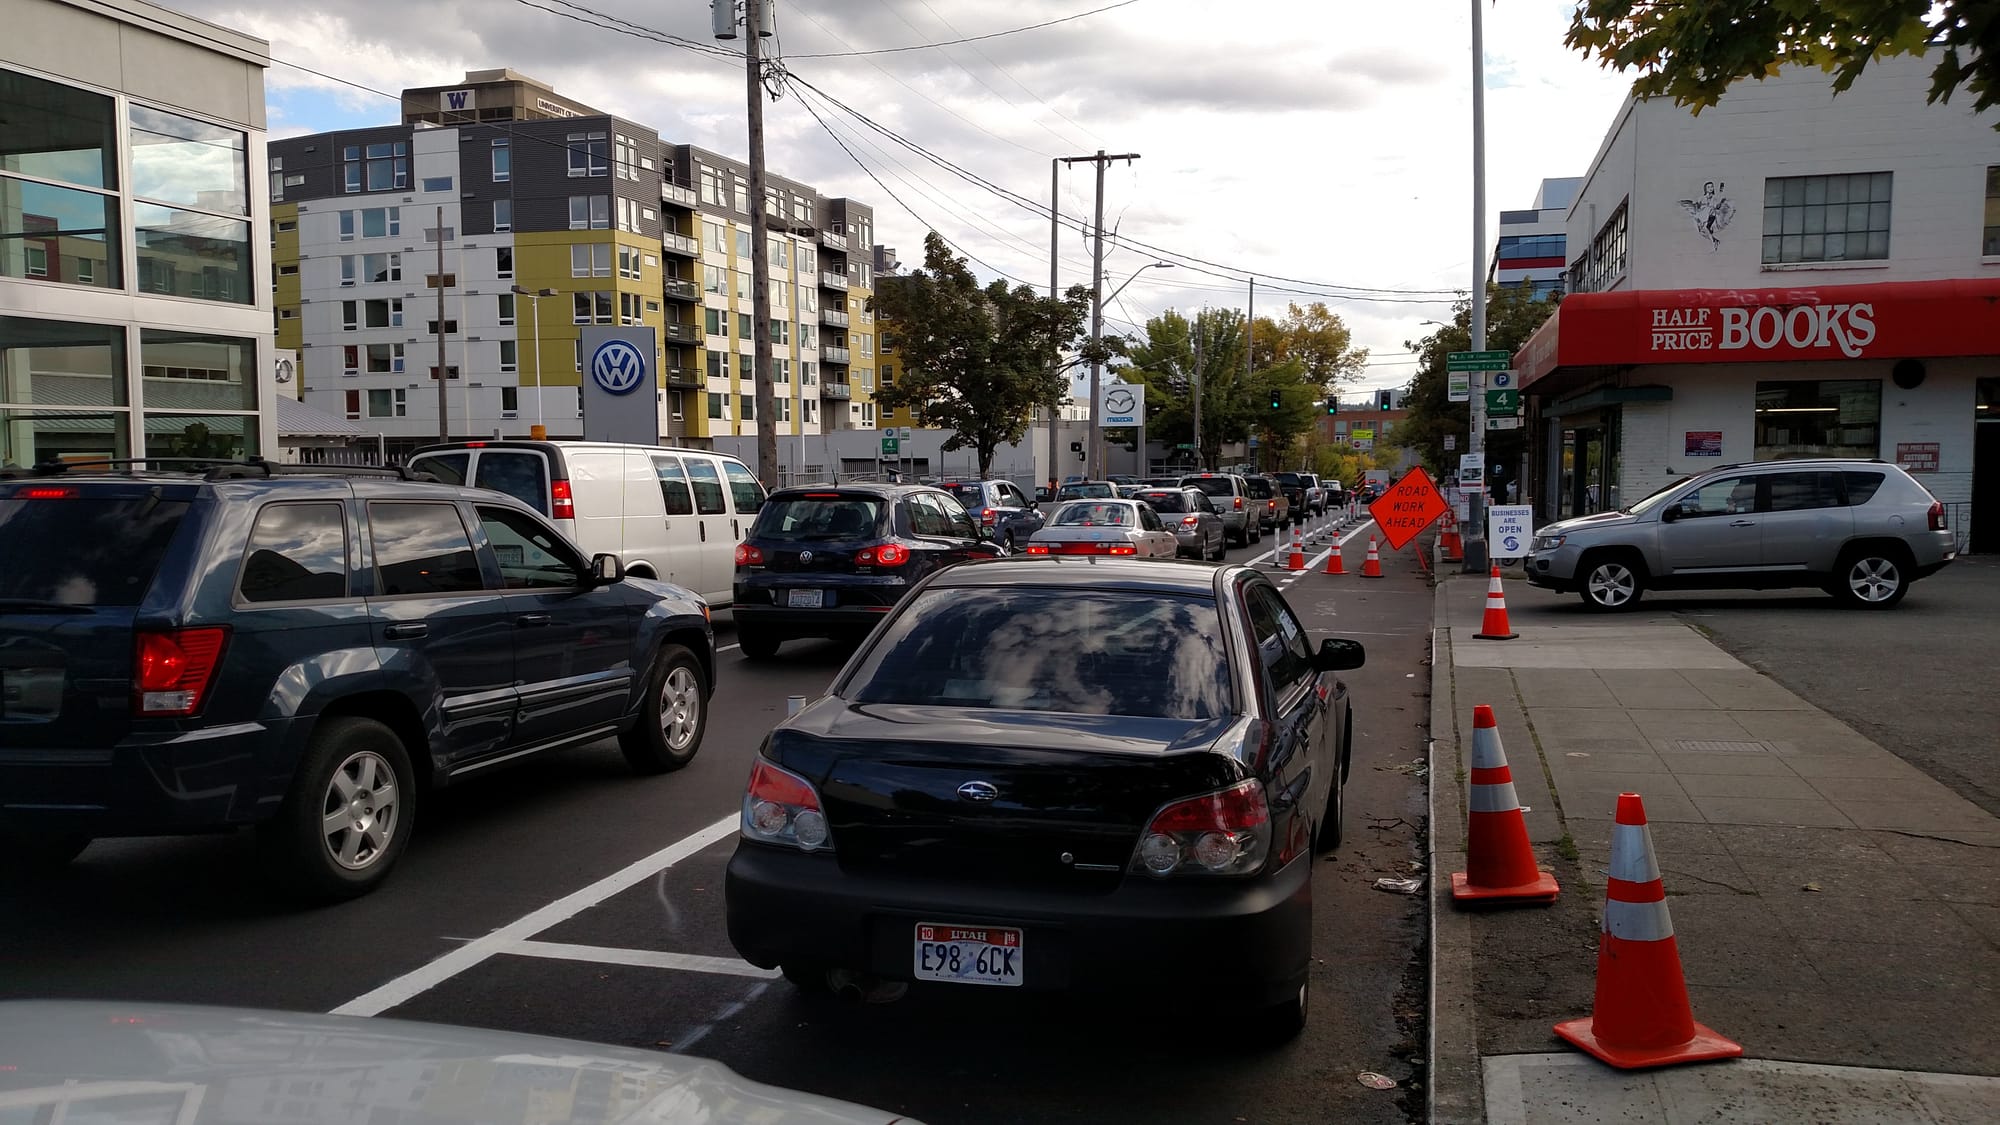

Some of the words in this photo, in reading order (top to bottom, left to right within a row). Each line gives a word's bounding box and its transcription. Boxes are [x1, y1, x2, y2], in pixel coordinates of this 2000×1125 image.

[447, 92, 468, 109] W
[539, 99, 564, 116] UNIVERSITY
[1652, 308, 1711, 327] HALF
[1718, 303, 1876, 358] BOOKS
[1651, 332, 1713, 350] PRICE
[1496, 392, 1508, 405] 4
[1397, 485, 1429, 497] ROAD
[1393, 501, 1425, 512] WORK
[1385, 517, 1425, 528] AHEAD
[1498, 526, 1522, 534] OPEN
[922, 928, 933, 940] 10
[951, 931, 987, 941] UTAH
[922, 943, 960, 973] E98
[976, 946, 1015, 976] 6CK
